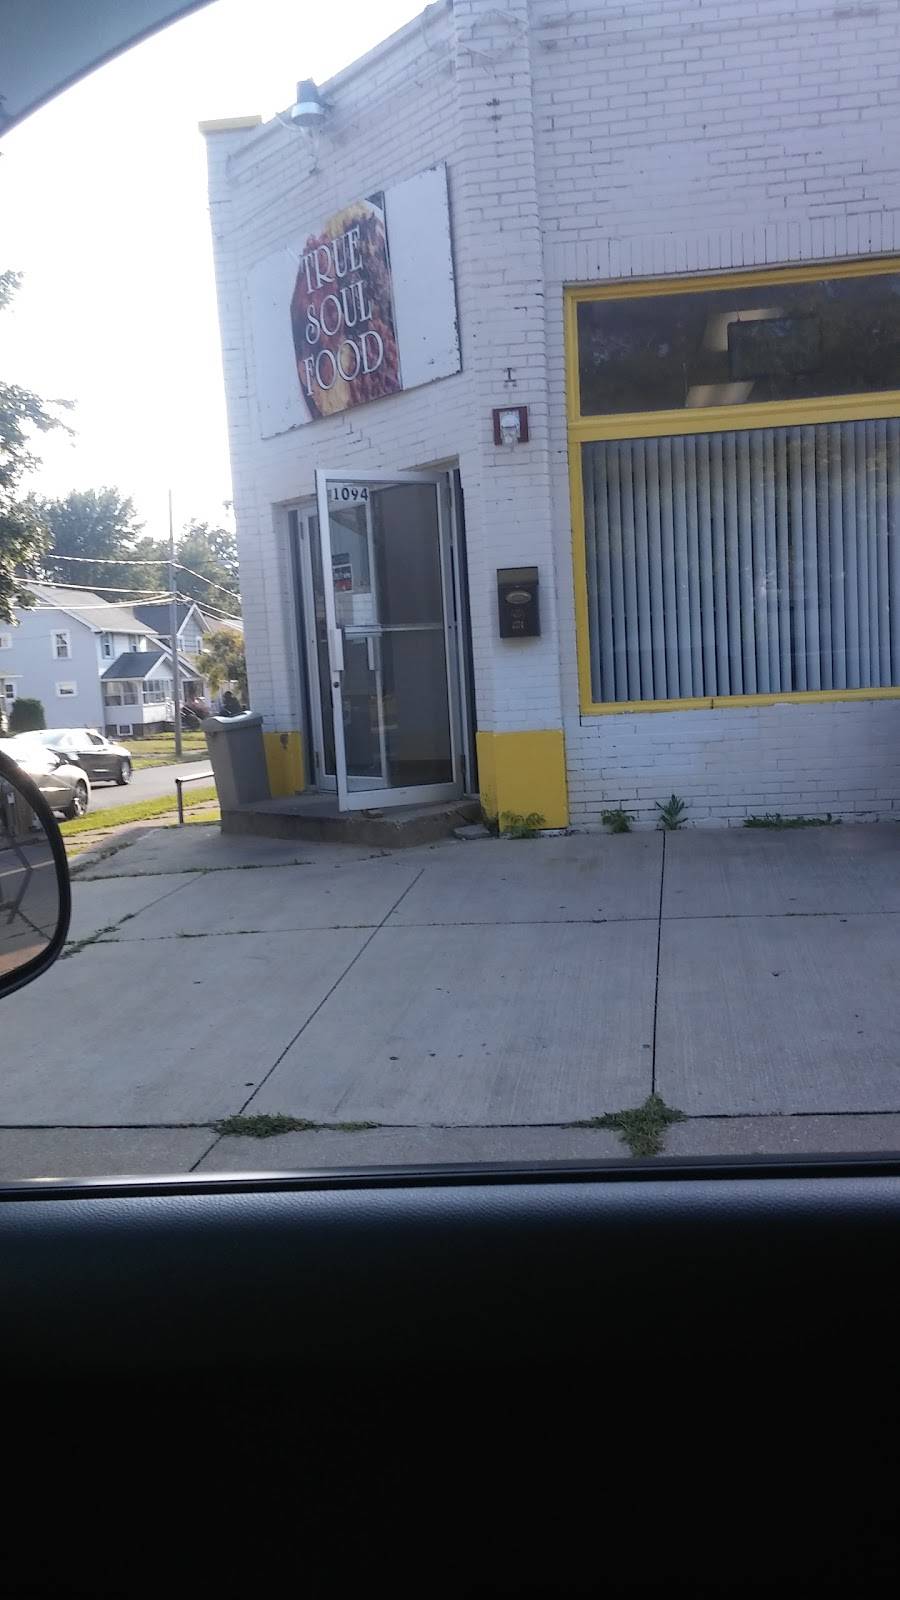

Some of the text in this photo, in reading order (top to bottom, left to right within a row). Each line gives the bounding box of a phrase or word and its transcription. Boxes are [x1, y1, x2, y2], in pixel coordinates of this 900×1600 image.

[301, 226, 363, 294] TRUE
[305, 279, 373, 345] SOUL
[303, 330, 384, 395] FOOD
[333, 487, 369, 502] 1094
